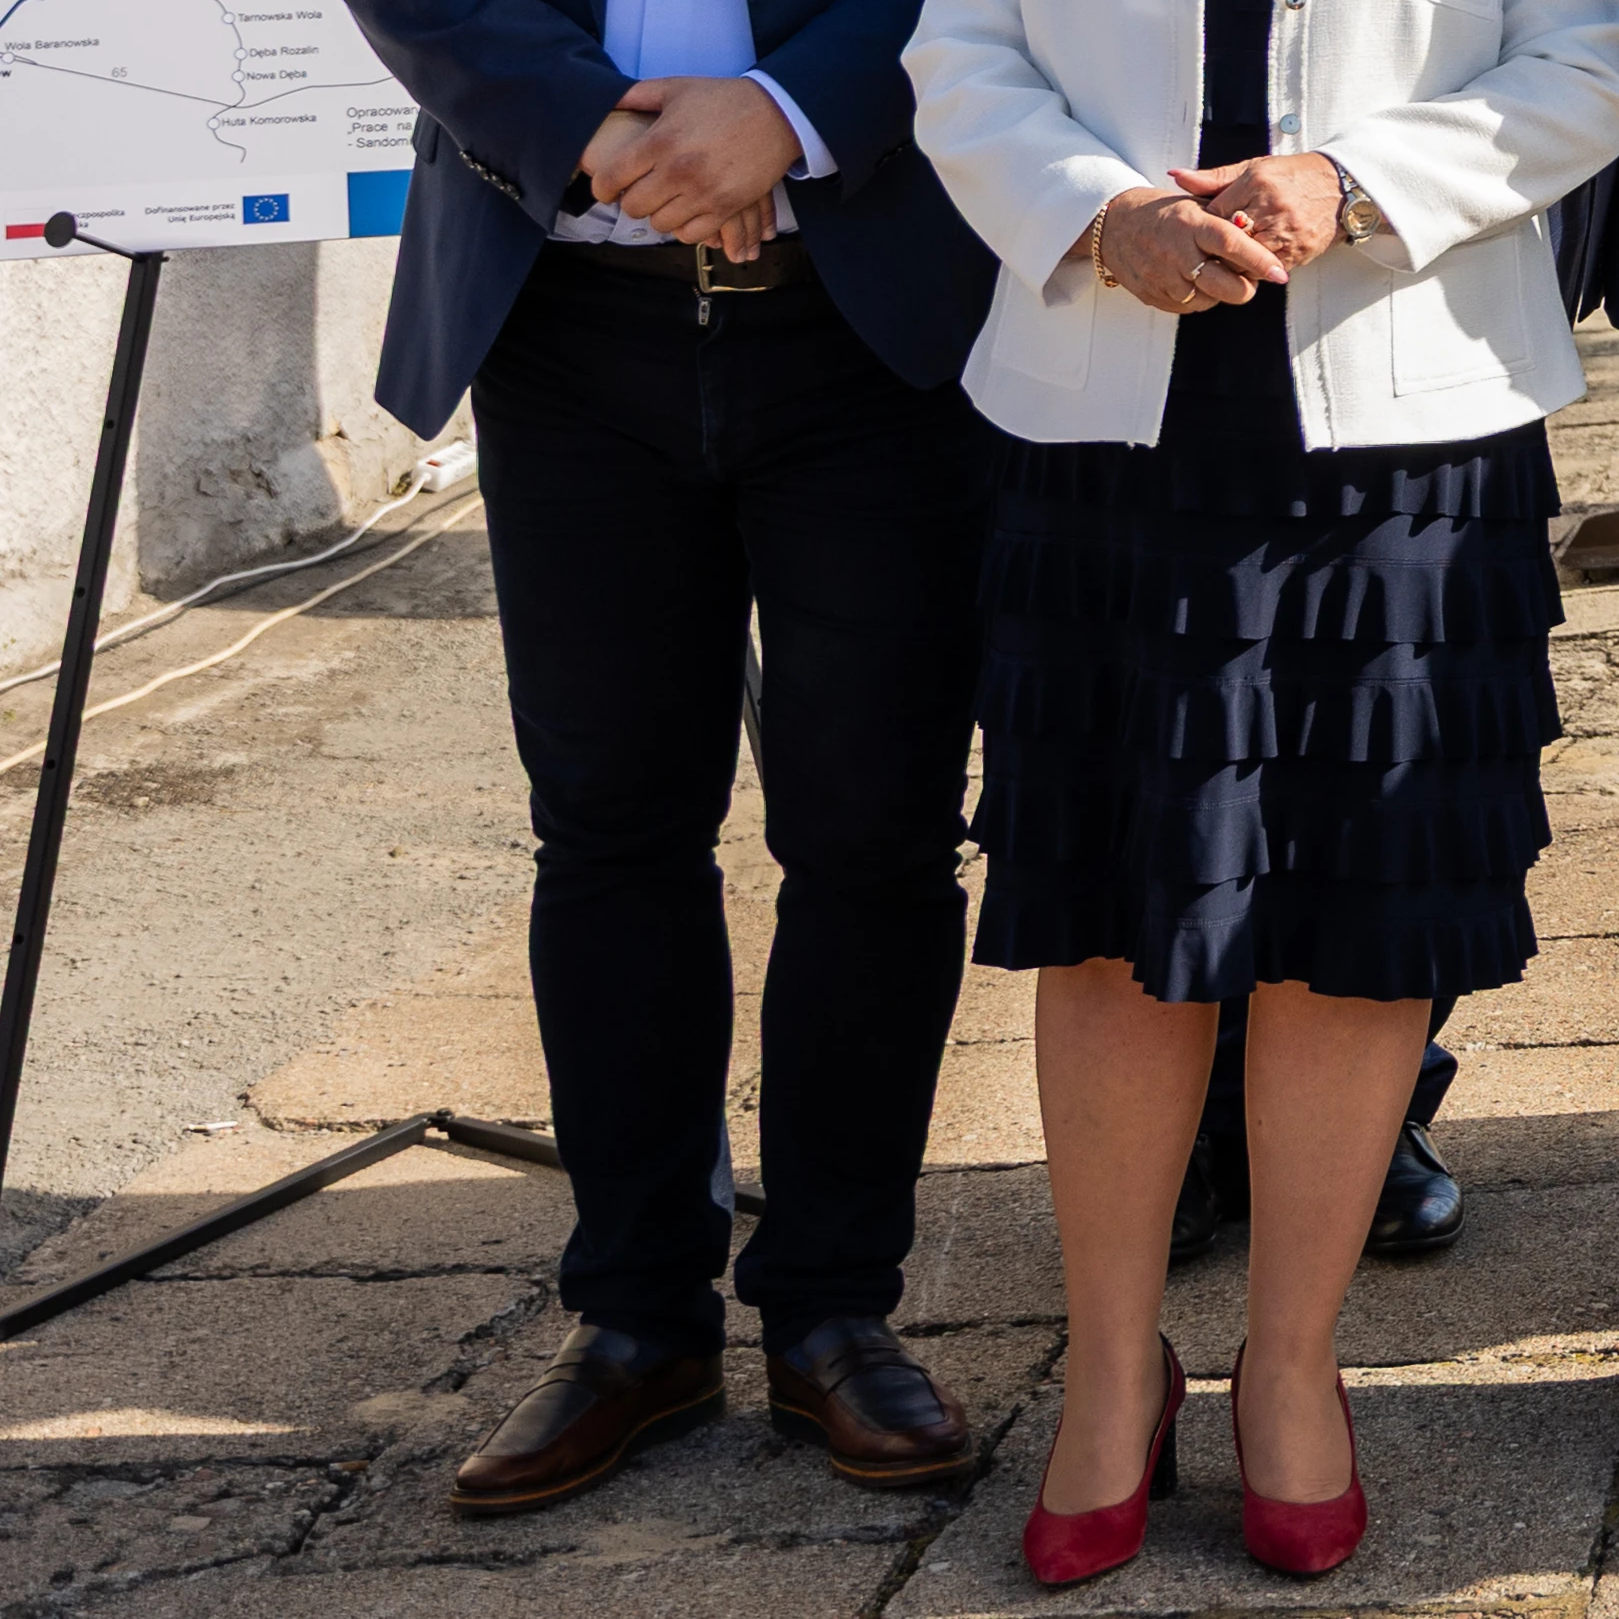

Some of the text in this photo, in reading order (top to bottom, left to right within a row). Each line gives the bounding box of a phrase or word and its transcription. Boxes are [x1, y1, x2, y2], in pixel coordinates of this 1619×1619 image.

[238, 11, 322, 23] Tarnowska Wola
[5, 38, 100, 51] Wola Baranowska
[249, 46, 319, 59] Dęba Rozalin
[111, 67, 128, 78] 65
[247, 70, 307, 81] Nowa Dęba
[221, 114, 317, 127] Huta Komorowska
[397, 122, 412, 131] na
[75, 209, 125, 220] czpospolita
[145, 203, 235, 215] Dofinansowane przez
[189, 212, 235, 222] Europejską
